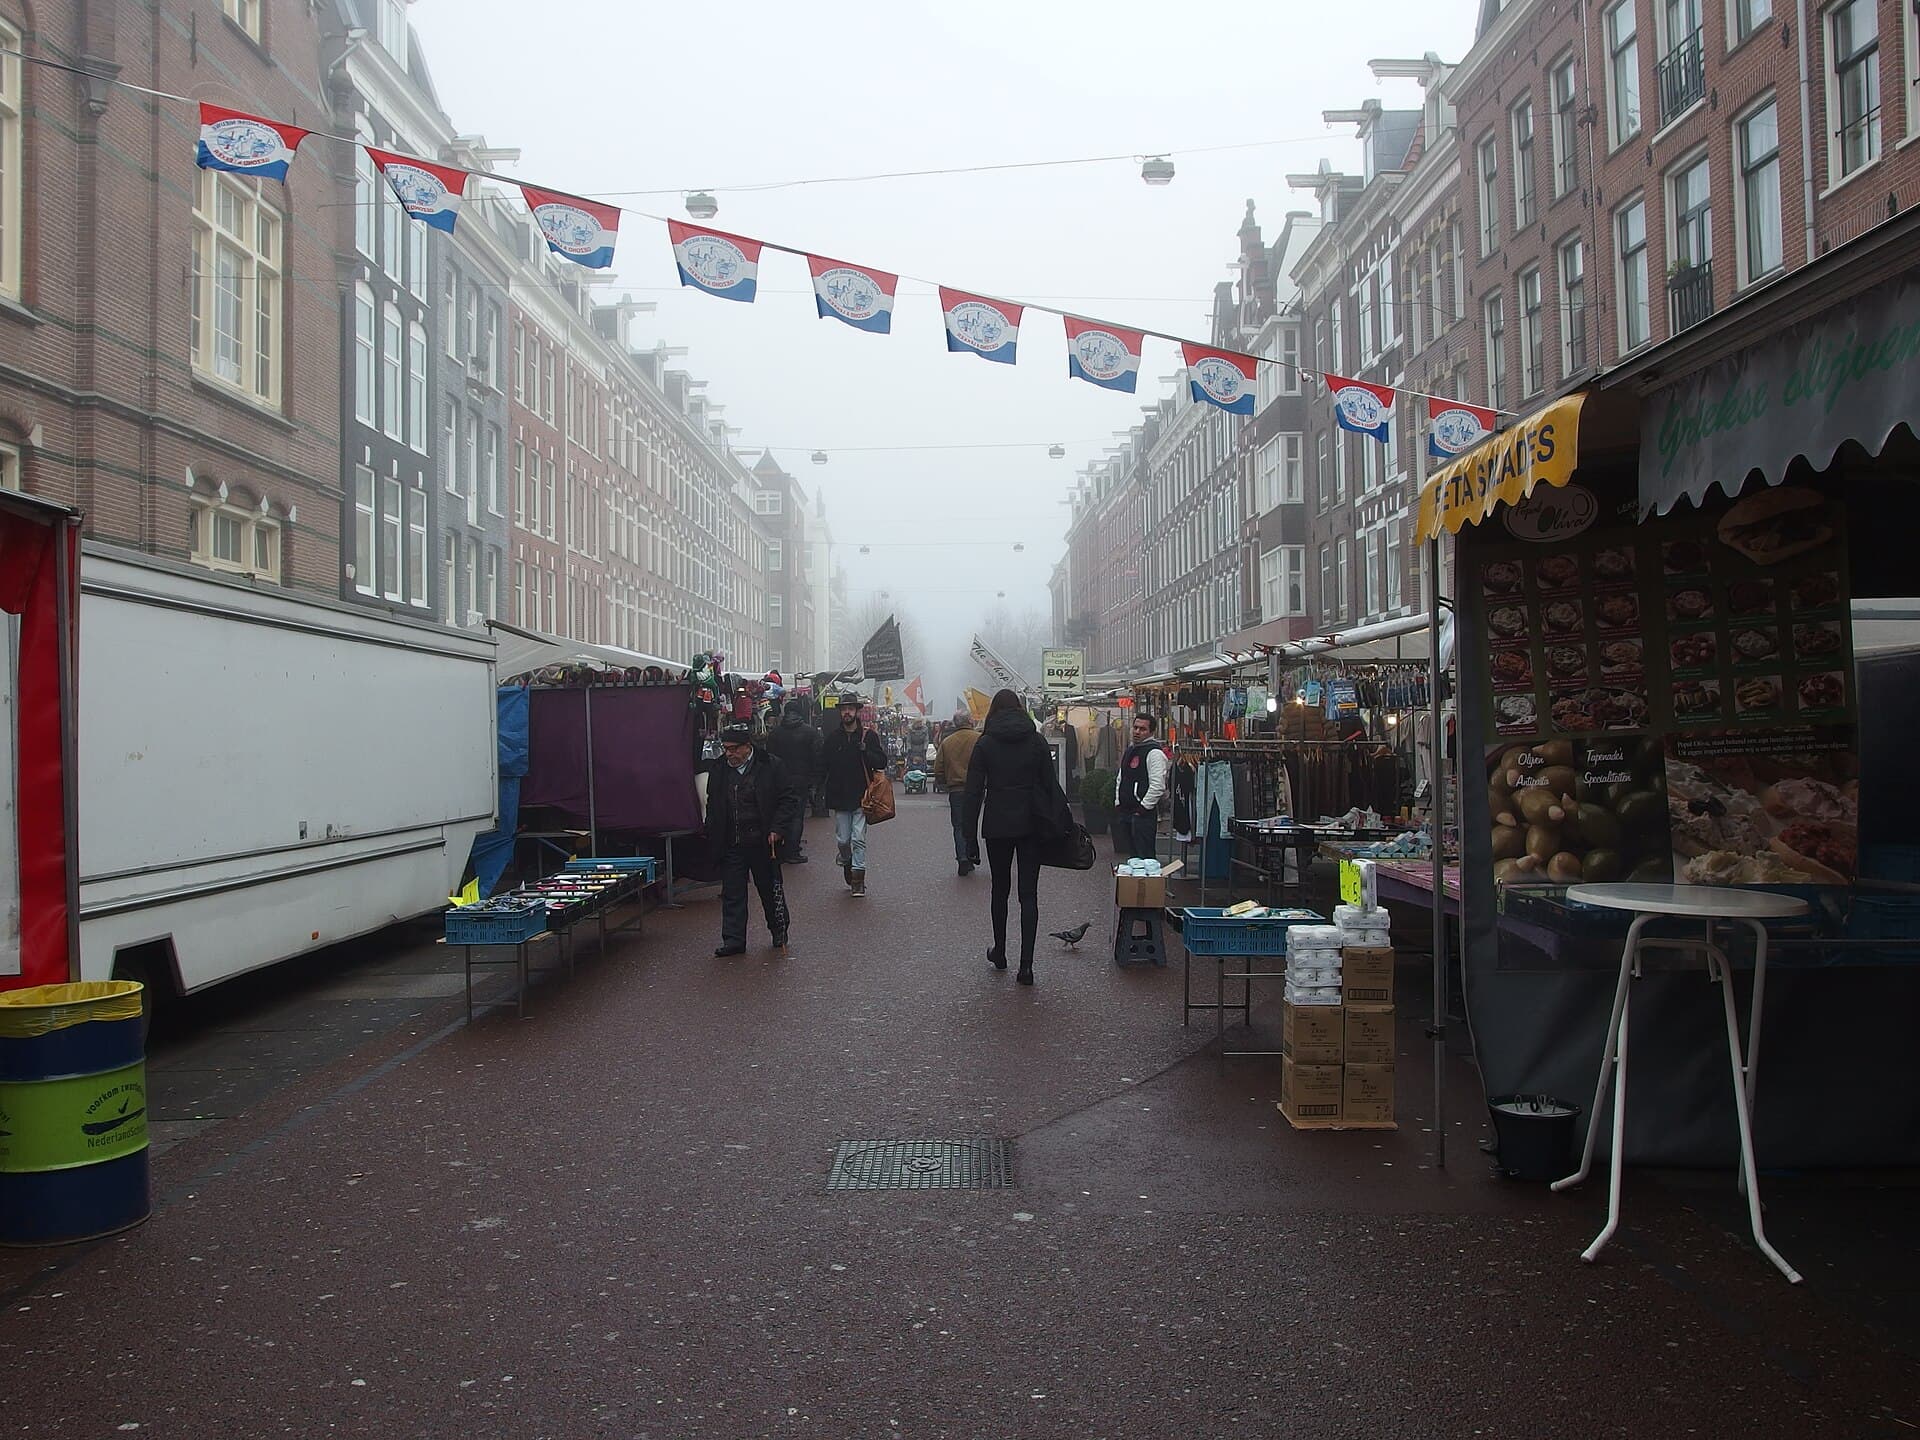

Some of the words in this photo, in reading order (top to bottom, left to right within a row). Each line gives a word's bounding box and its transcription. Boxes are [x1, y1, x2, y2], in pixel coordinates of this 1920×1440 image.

[1435, 472, 1474, 516] FETA
[1537, 505, 1587, 532] Oliva
[1047, 667, 1079, 678] BOZZ
[86, 1087, 119, 1115] voorkom
